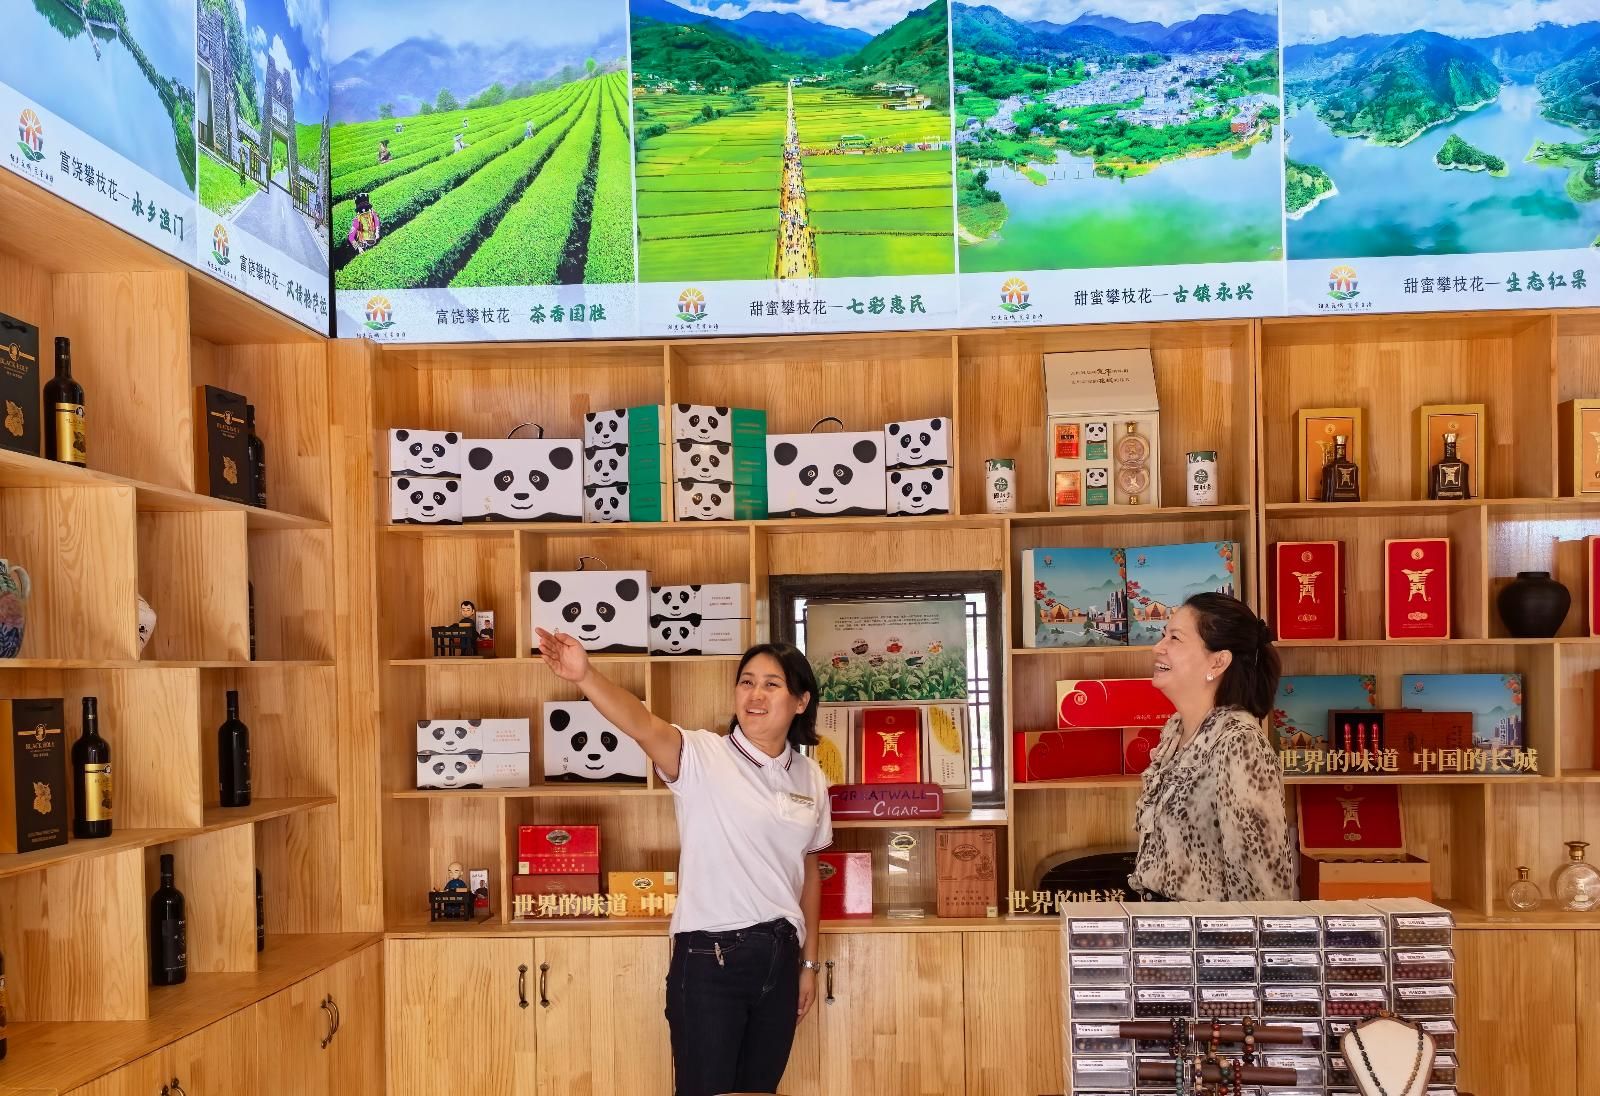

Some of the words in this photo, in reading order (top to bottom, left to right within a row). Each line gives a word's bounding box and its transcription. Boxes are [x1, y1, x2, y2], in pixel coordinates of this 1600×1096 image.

[530, 303, 607, 324] 茶香国胜
[1279, 748, 1399, 773] 世界的味道
[1413, 747, 1538, 773] 中国的长城
[840, 790, 928, 801] GRATWALL
[512, 893, 628, 917] 世界的味道
